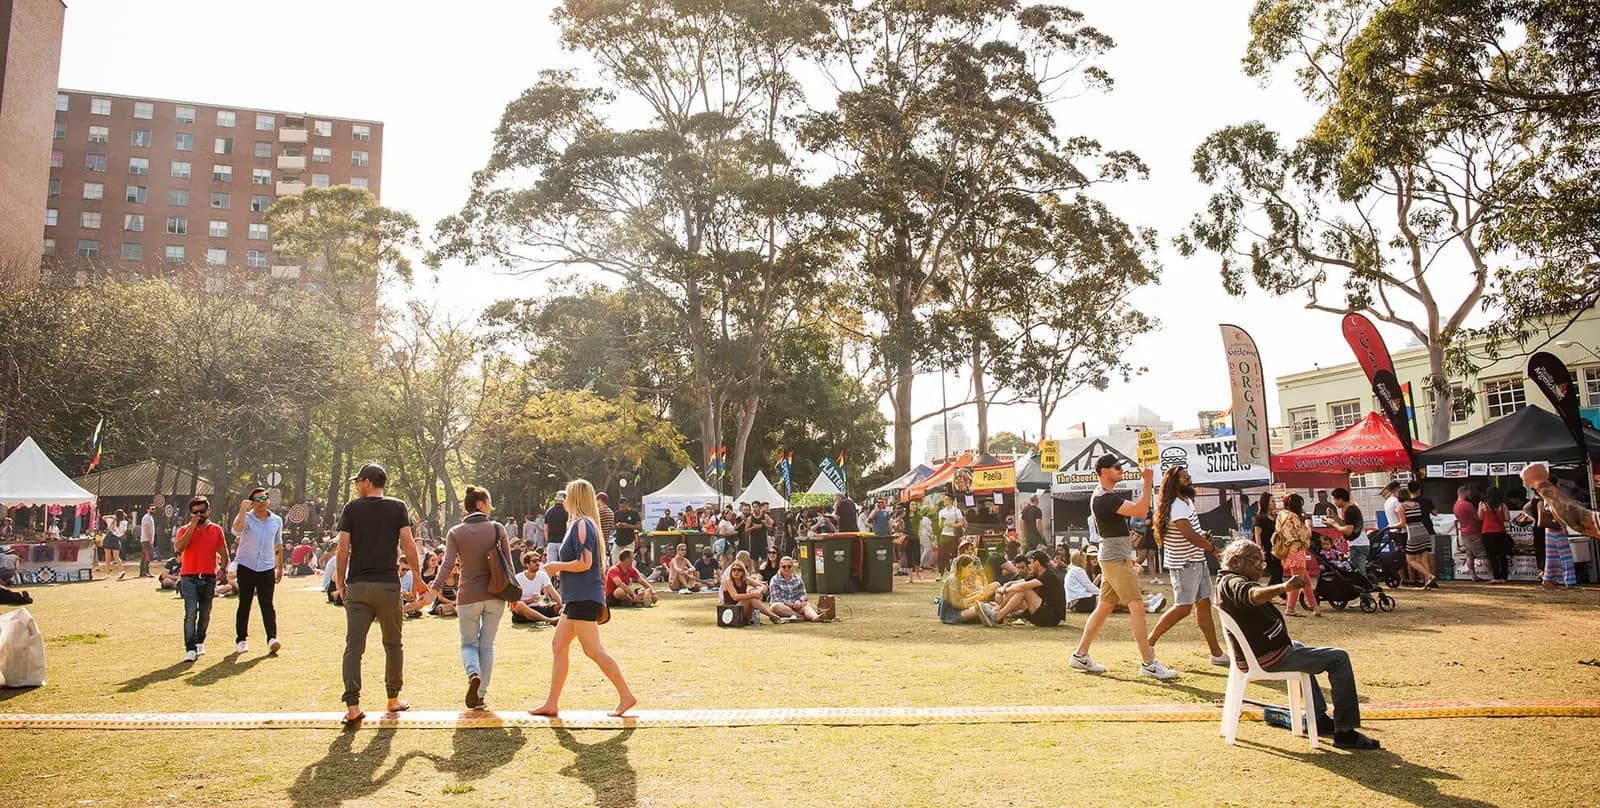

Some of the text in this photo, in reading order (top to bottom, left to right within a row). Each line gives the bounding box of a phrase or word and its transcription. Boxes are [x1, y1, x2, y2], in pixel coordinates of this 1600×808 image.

[1239, 361, 1261, 459] ORGANIC
[1140, 431, 1153, 439] COLD
[1196, 441, 1222, 456] NEW
[983, 471, 1002, 481] Paella
[1057, 474, 1070, 484] The
